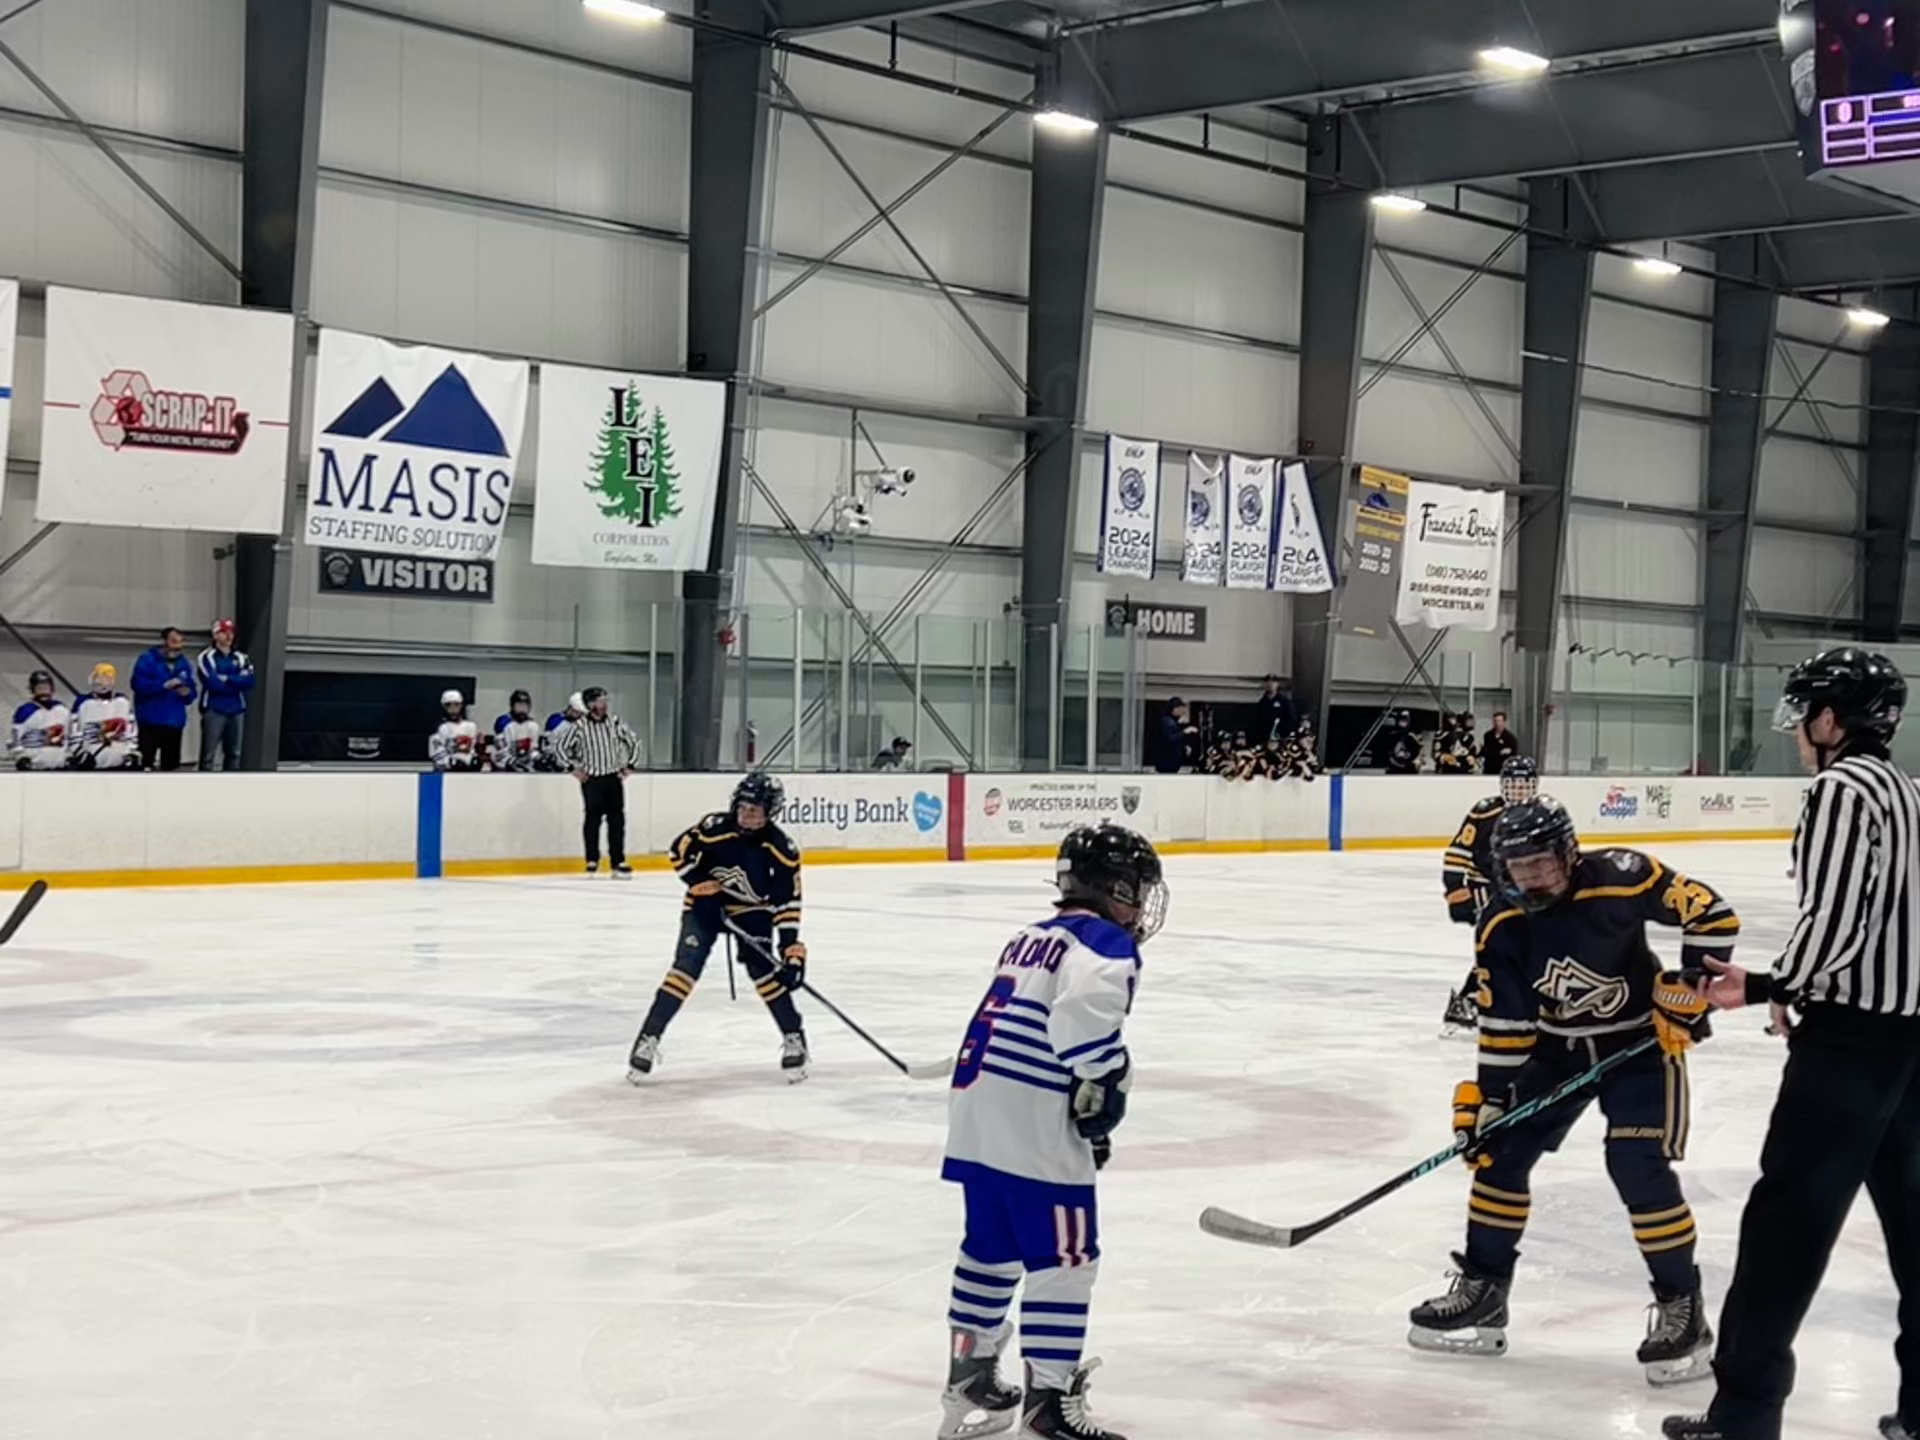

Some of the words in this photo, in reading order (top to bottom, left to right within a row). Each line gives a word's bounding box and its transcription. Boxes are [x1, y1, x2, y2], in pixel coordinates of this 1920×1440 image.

[141, 391, 236, 434] SCRAP-IT
[313, 448, 510, 526] MASIS
[309, 516, 408, 545] STAFFING
[1109, 526, 1150, 547] 2024
[1231, 542, 1266, 560] 2024
[361, 557, 488, 592] VISITOR
[1136, 608, 1196, 635] HOME
[776, 797, 848, 830] idelity
[854, 797, 909, 823] Bank
[1007, 797, 1073, 812] WORCESTER
[1074, 798, 1119, 812] RAILERS
